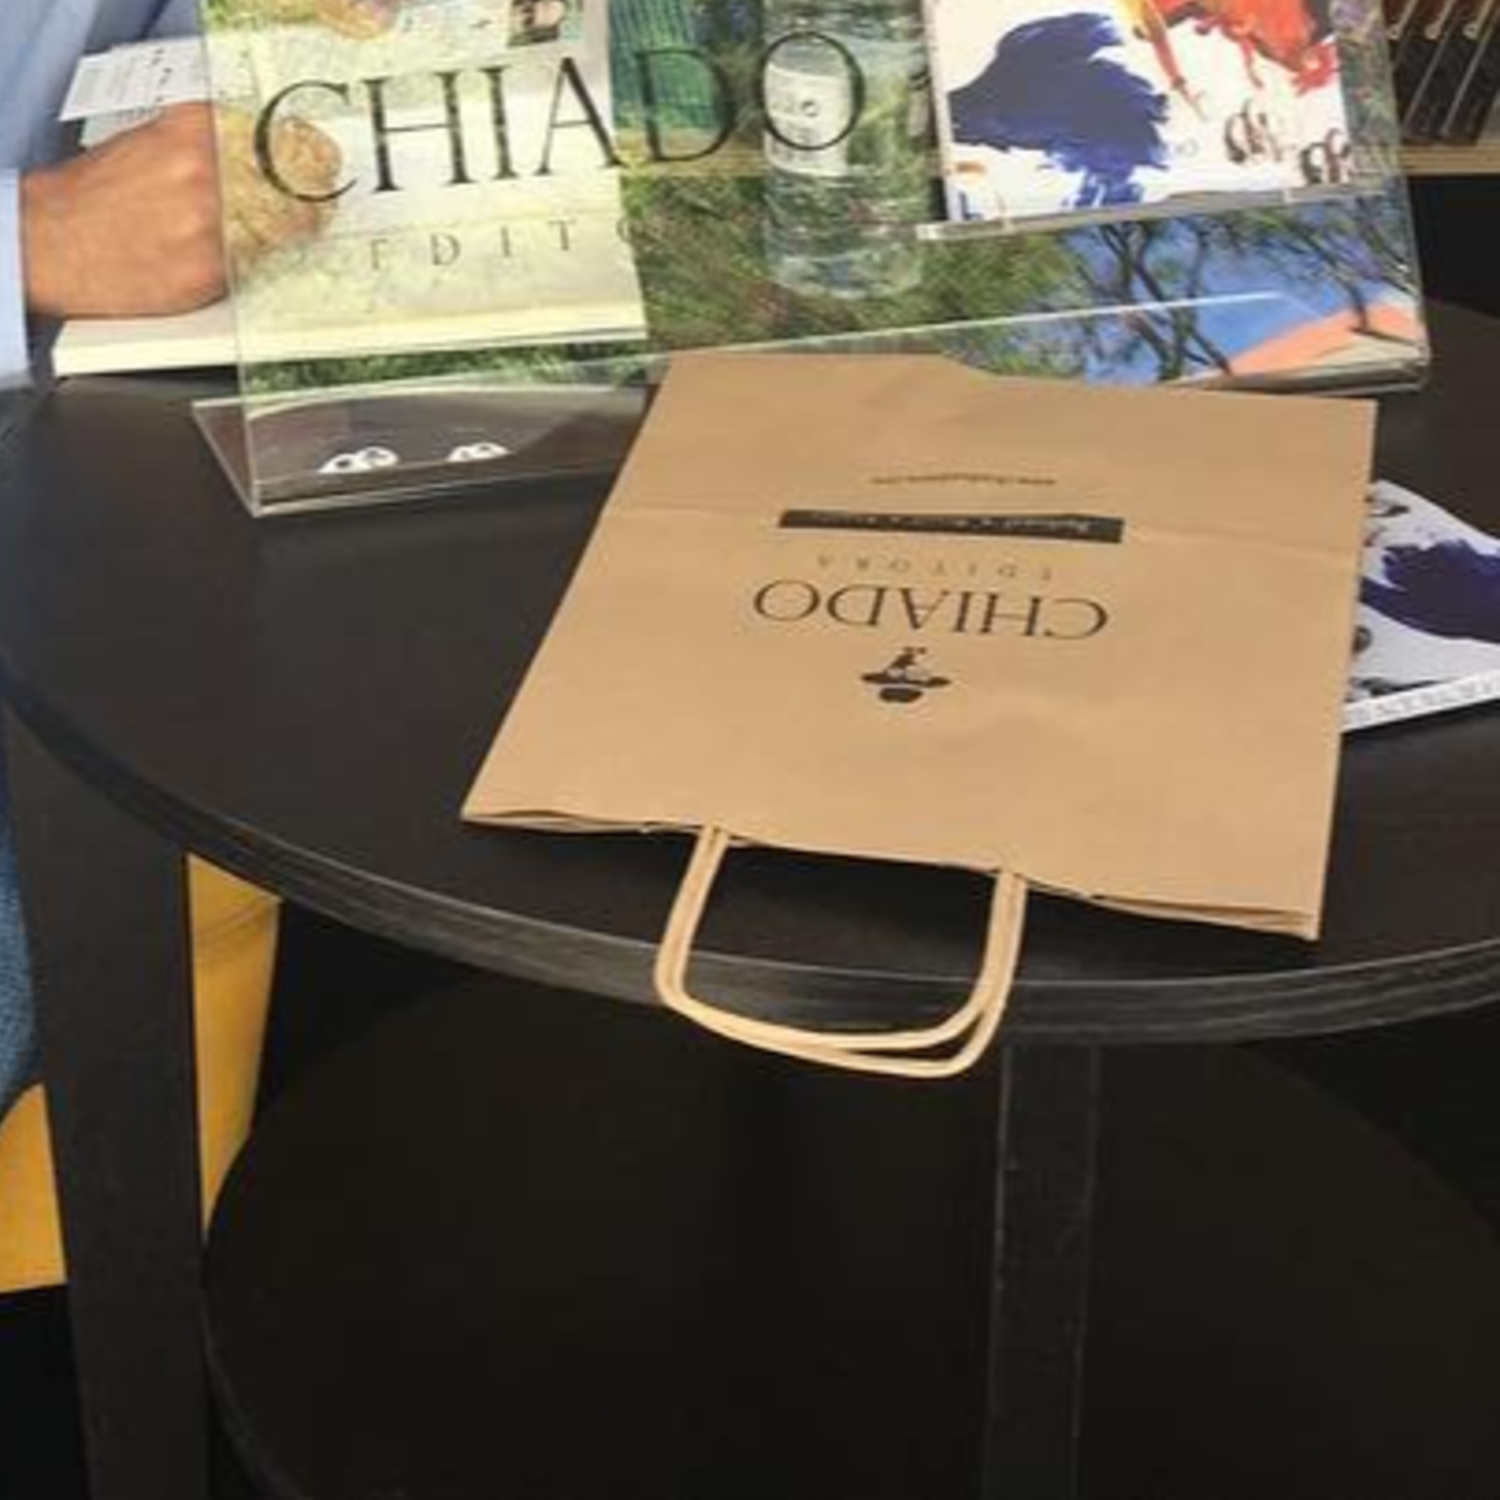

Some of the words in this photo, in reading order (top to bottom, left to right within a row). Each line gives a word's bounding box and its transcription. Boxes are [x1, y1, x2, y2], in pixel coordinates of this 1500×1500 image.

[254, 31, 866, 201] CHIADO
[816, 554, 1053, 582] EDITORA
[753, 579, 1110, 641] CHIADO
